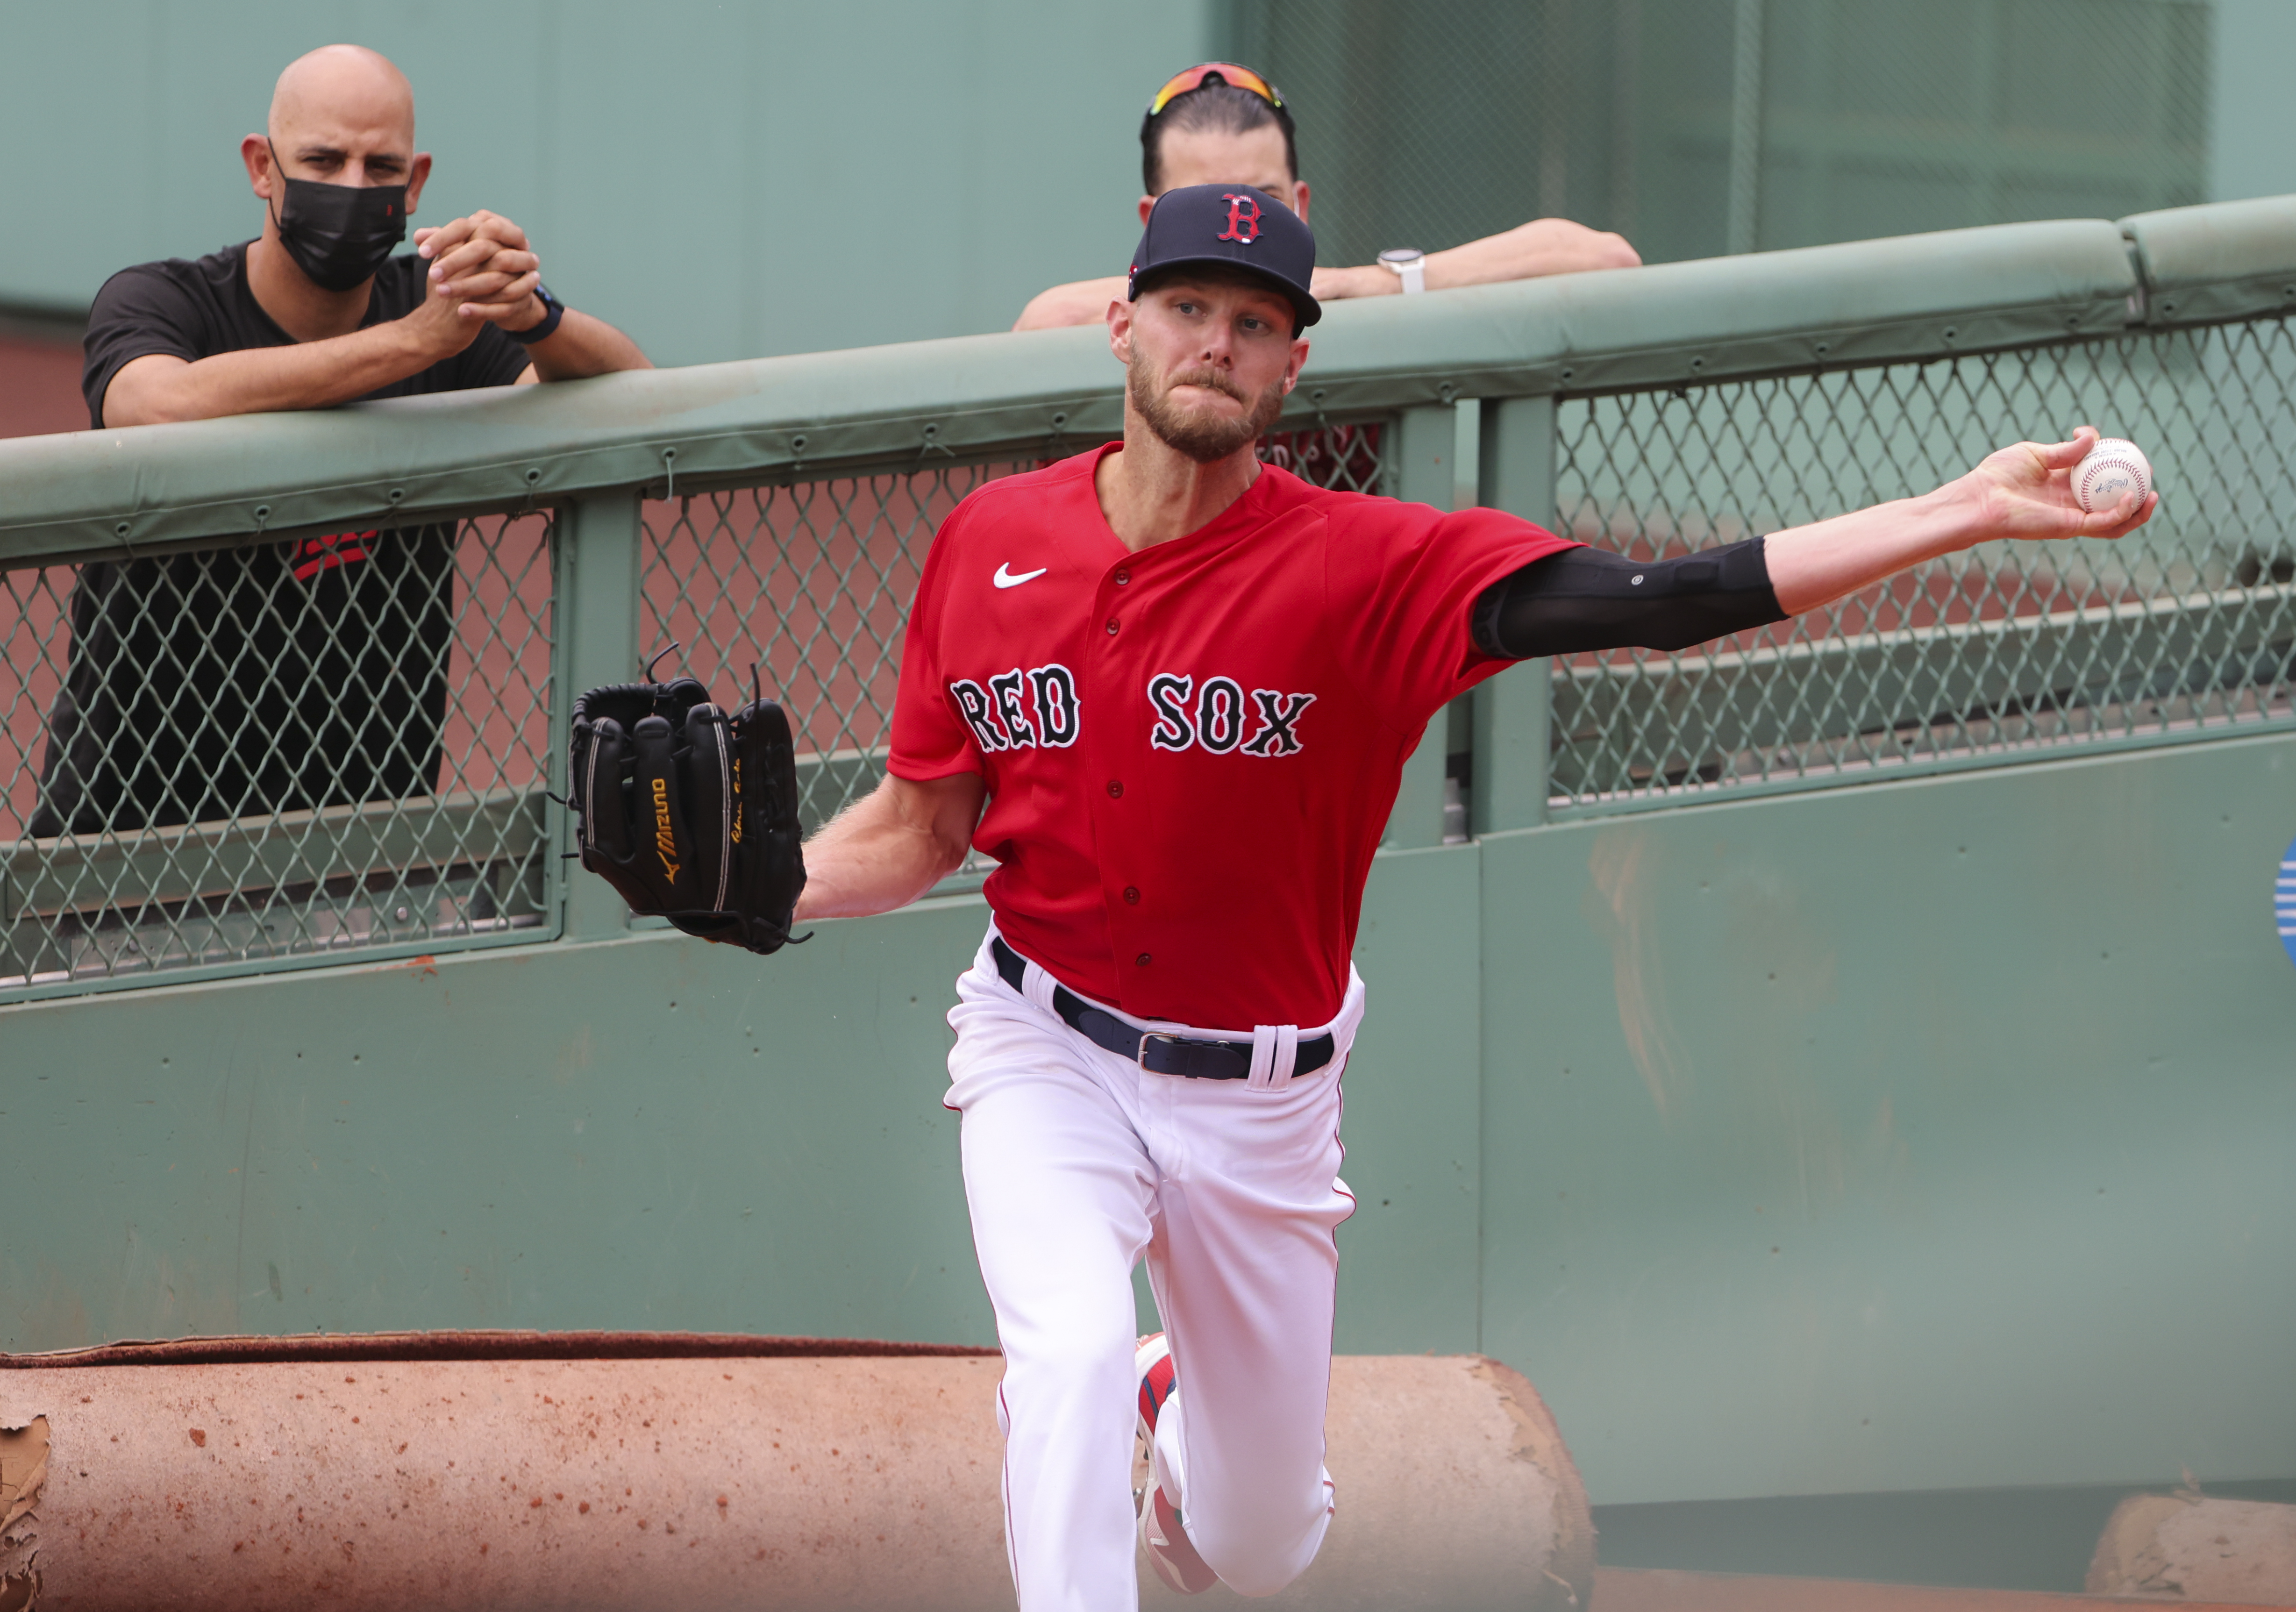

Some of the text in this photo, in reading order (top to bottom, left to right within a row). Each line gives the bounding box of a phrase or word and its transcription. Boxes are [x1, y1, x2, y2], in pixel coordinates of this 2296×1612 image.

[1217, 193, 1266, 245] B
[2095, 478, 2128, 494] Rawlings
[949, 663, 1317, 758] RED SOX
[651, 778, 677, 857] MIZUNO
